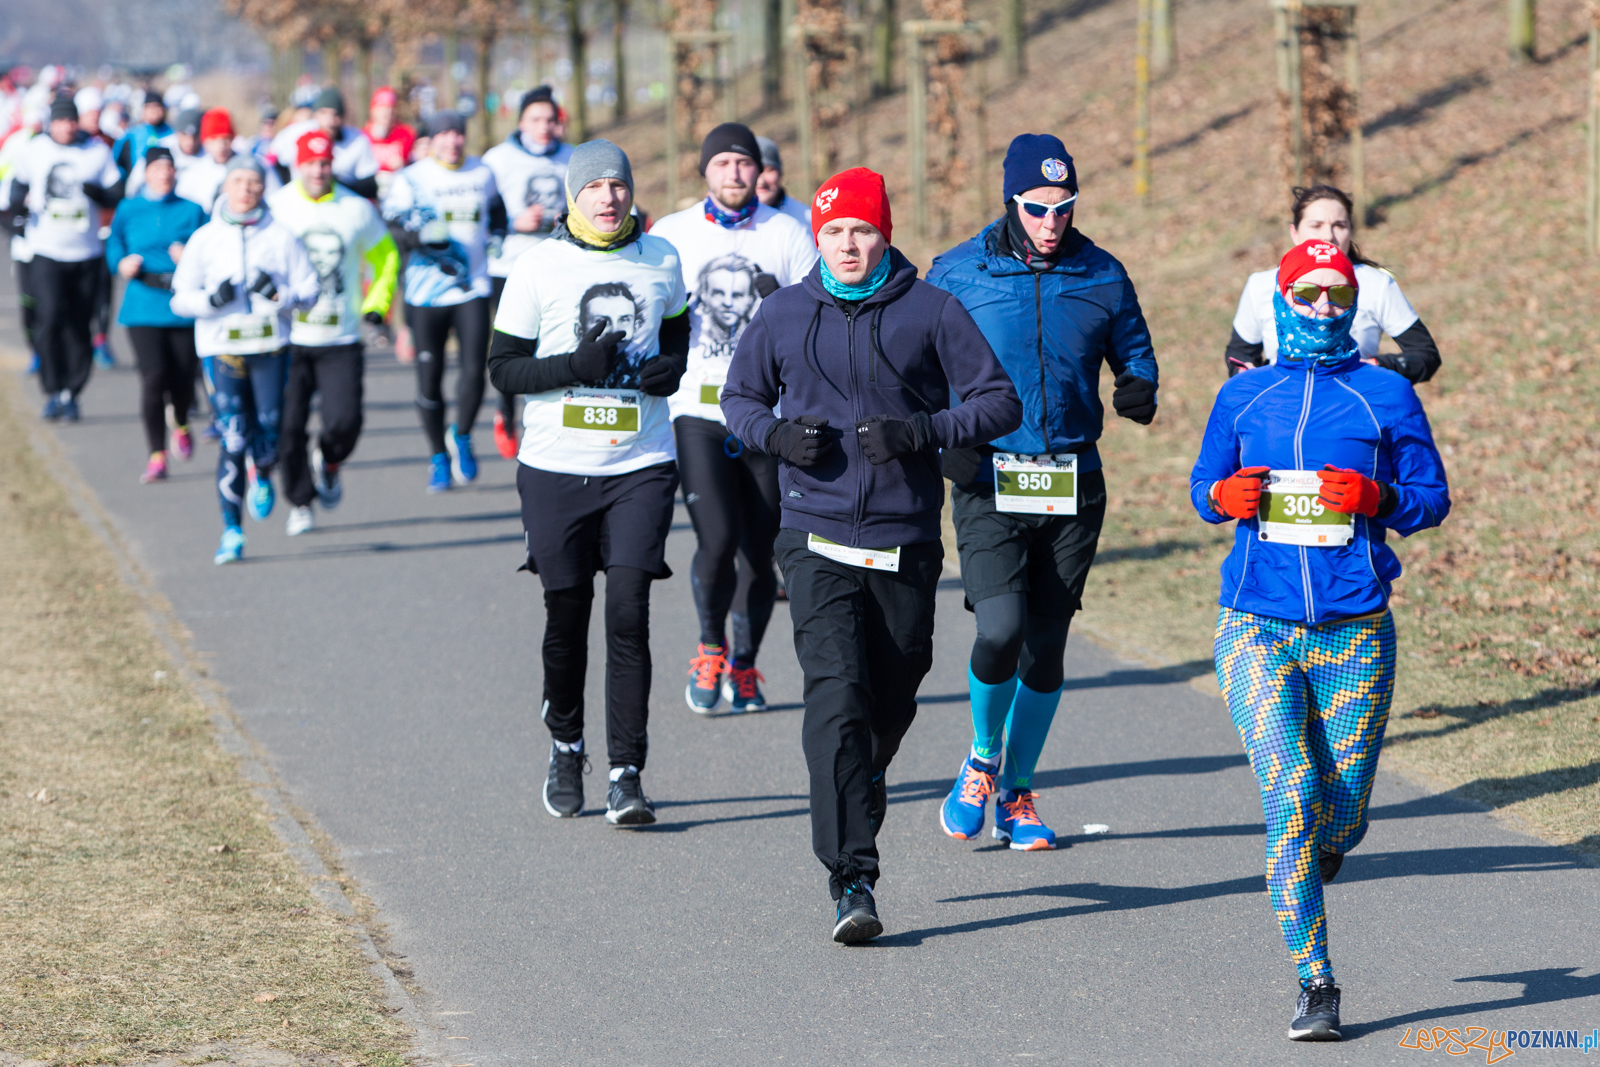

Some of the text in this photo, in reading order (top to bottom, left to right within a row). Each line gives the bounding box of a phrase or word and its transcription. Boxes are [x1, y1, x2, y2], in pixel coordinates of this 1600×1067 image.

[583, 407, 618, 425] 838
[1017, 473, 1052, 490] 950
[1283, 495, 1325, 517] 309
